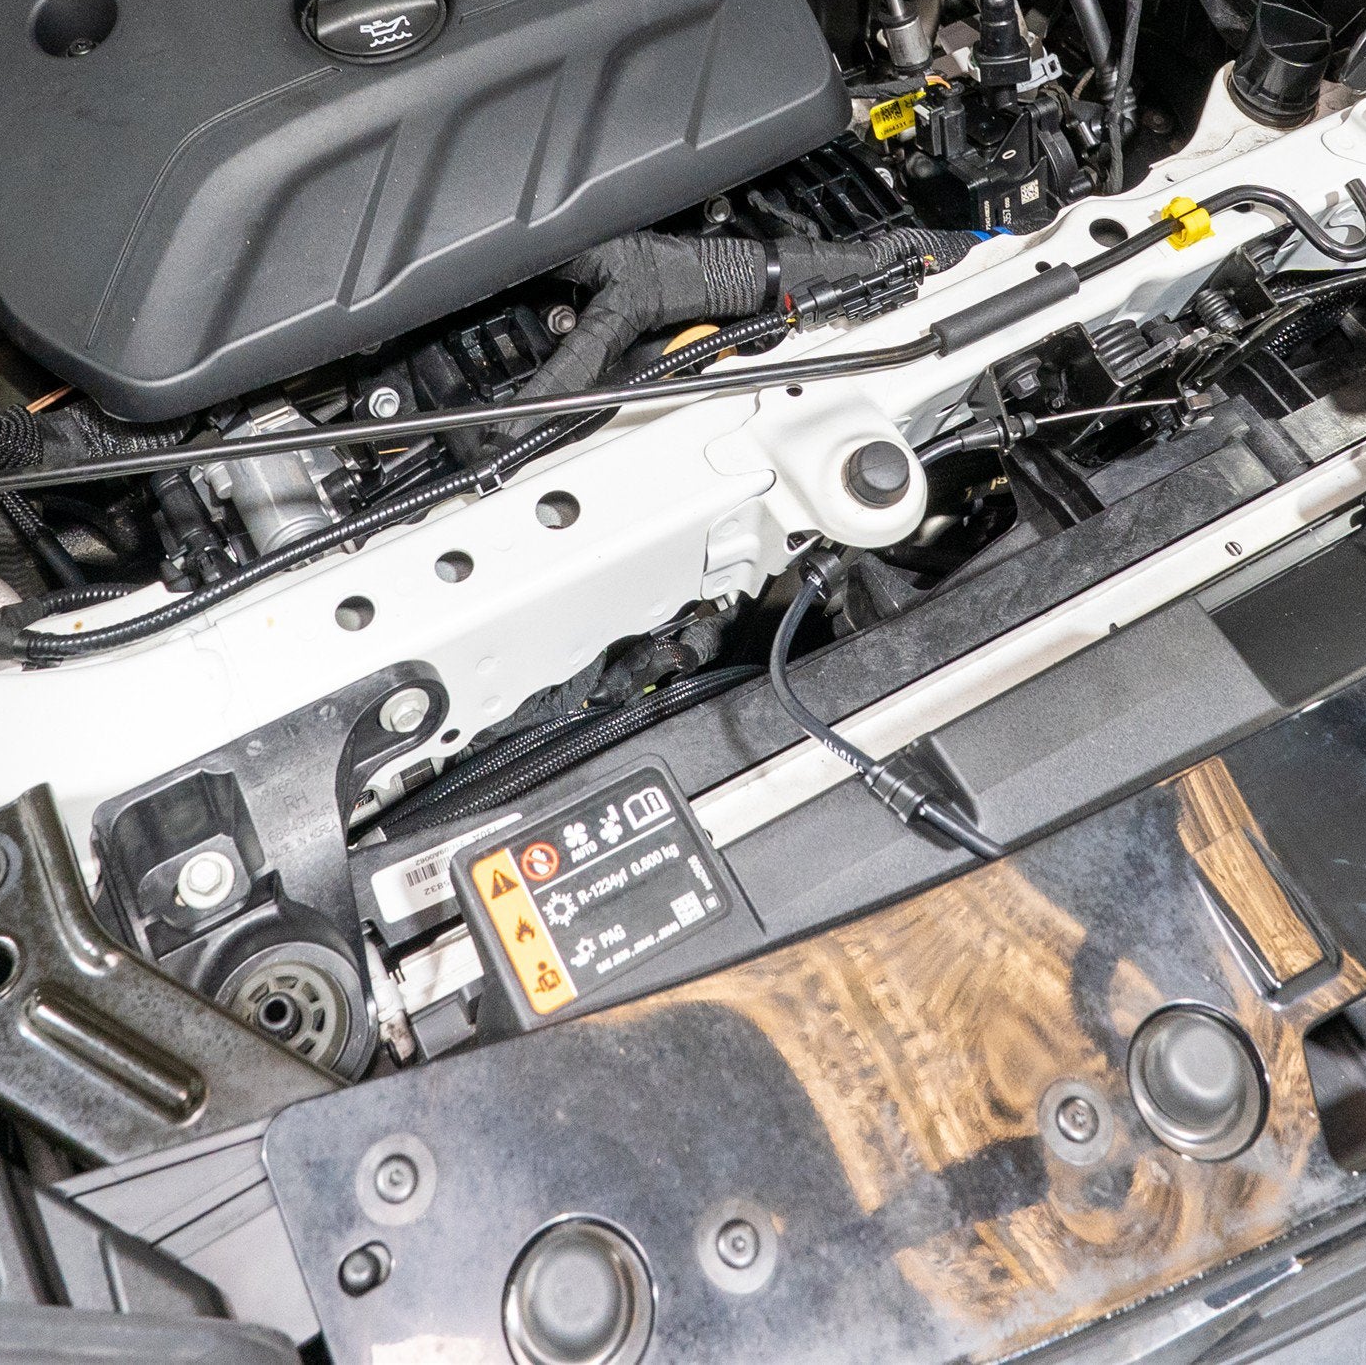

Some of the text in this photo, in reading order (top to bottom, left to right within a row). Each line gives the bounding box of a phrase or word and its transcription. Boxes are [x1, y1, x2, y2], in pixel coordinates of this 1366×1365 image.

[283, 788, 310, 814] RH
[570, 840, 598, 863] AUTO
[576, 867, 629, 905] R-1234yf
[660, 843, 680, 860] kg
[598, 923, 627, 949] PAG
